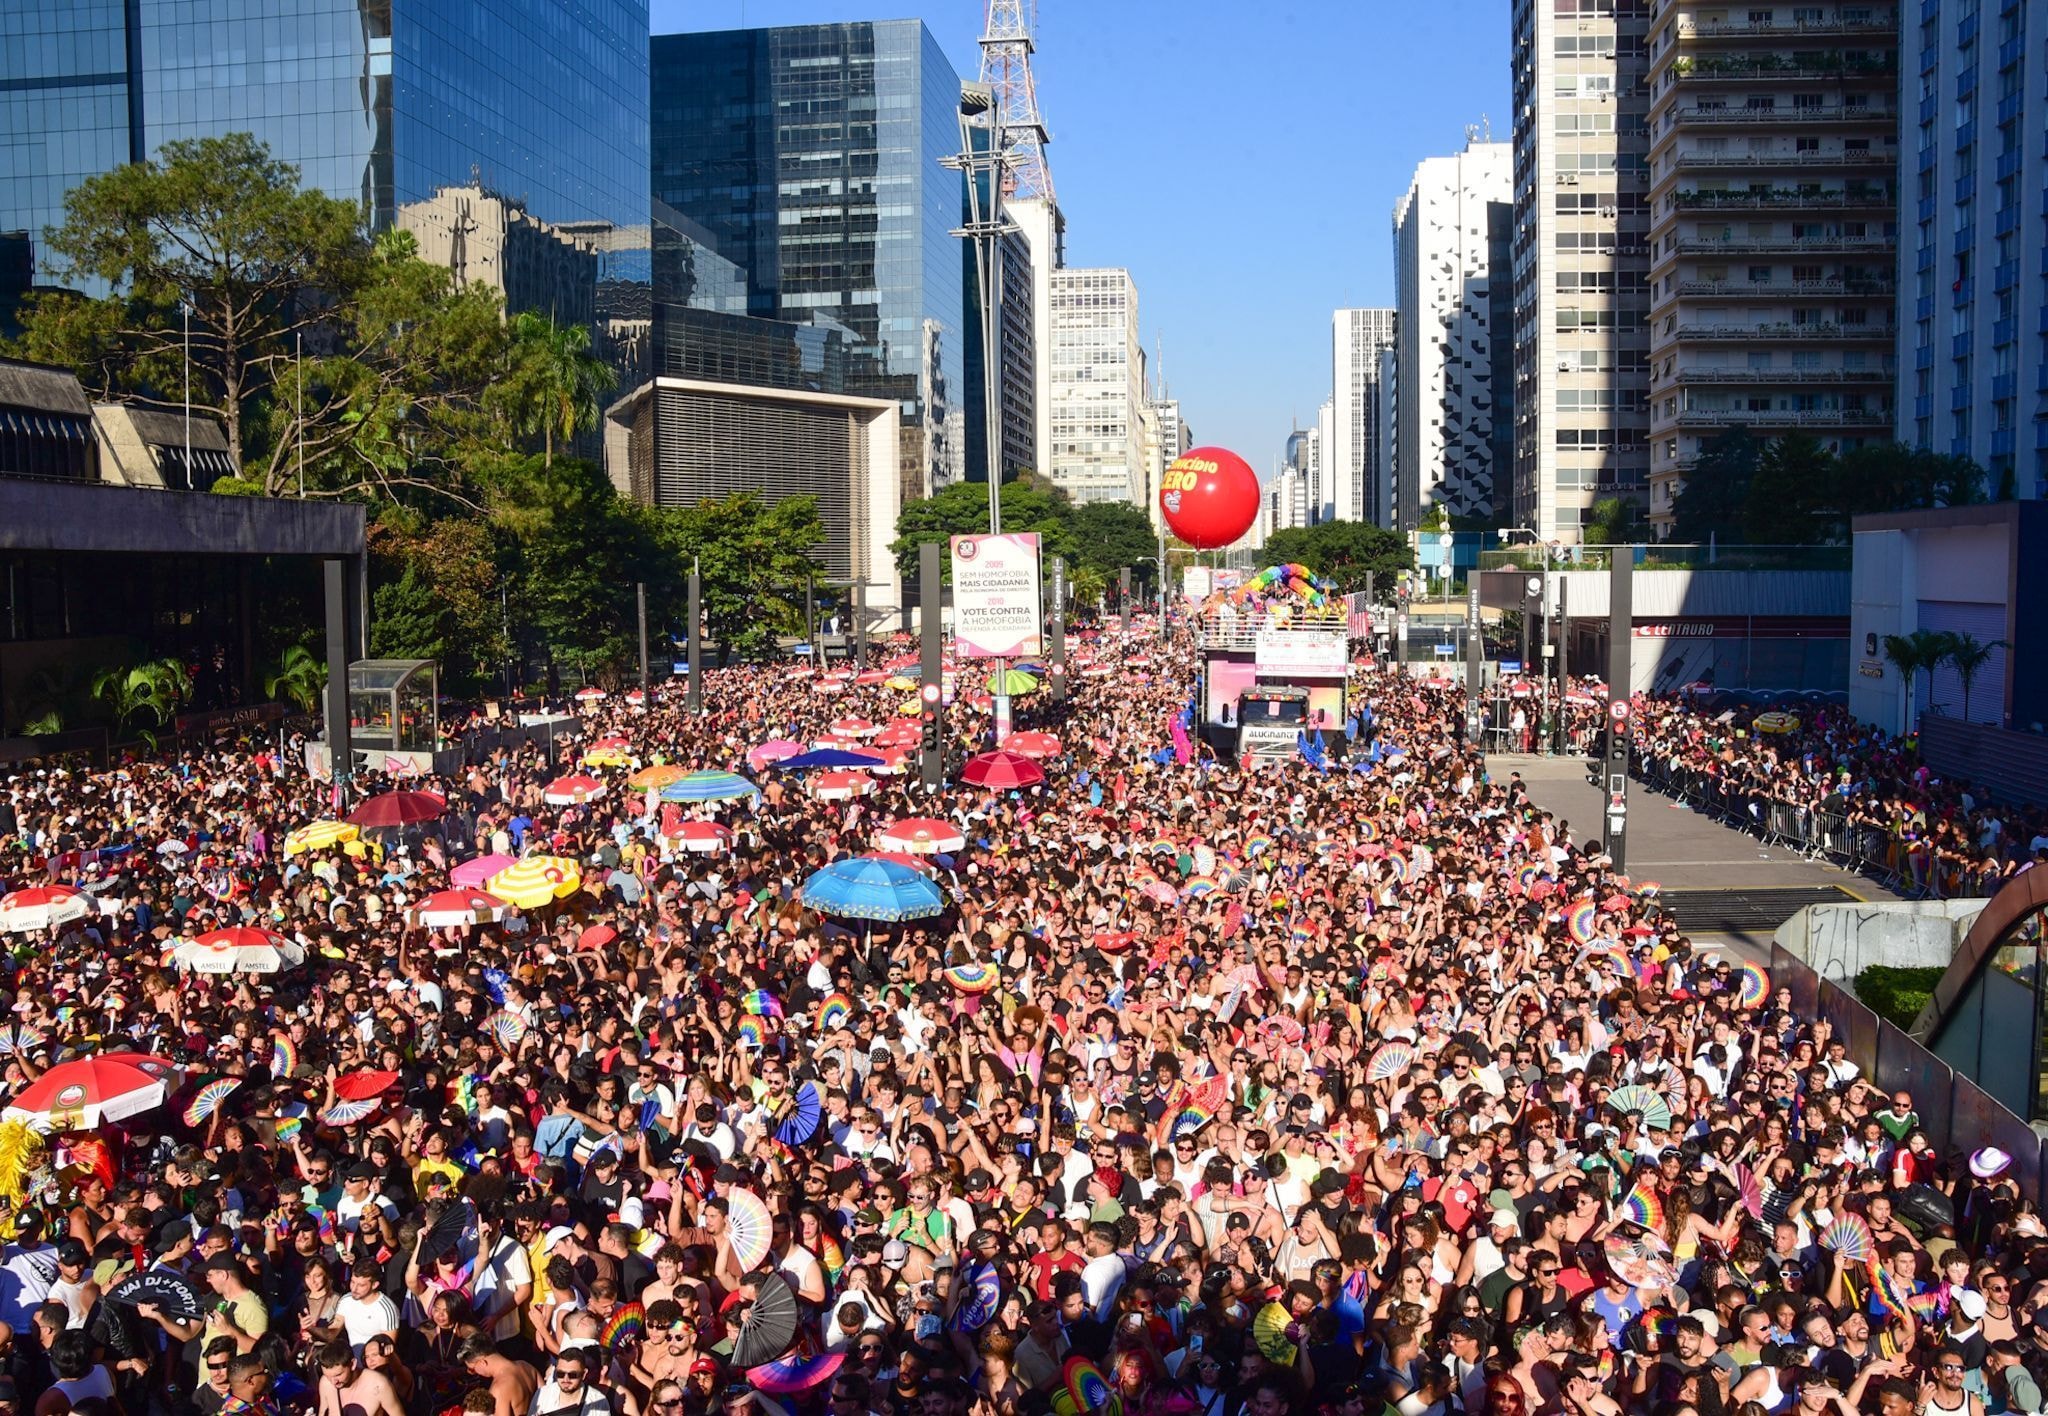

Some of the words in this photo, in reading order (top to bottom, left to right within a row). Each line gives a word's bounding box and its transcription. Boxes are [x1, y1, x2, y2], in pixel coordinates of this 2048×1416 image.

[960, 571, 977, 579] SEM
[960, 579, 981, 587] MAIS
[982, 578, 1030, 587] CIDADANIA
[1054, 574, 1062, 610] Campinas
[989, 606, 1031, 615] CONTRA
[1470, 589, 1479, 630] Pamplona
[962, 617, 969, 625] A
[971, 616, 1032, 625] HOMOFOBIA
[1470, 631, 1477, 641] R.
[18, 919, 41, 928] AMSTEL
[58, 909, 80, 919] AMSTEL
[200, 962, 227, 970] AMSTEL
[244, 962, 271, 970] AMSTEL
